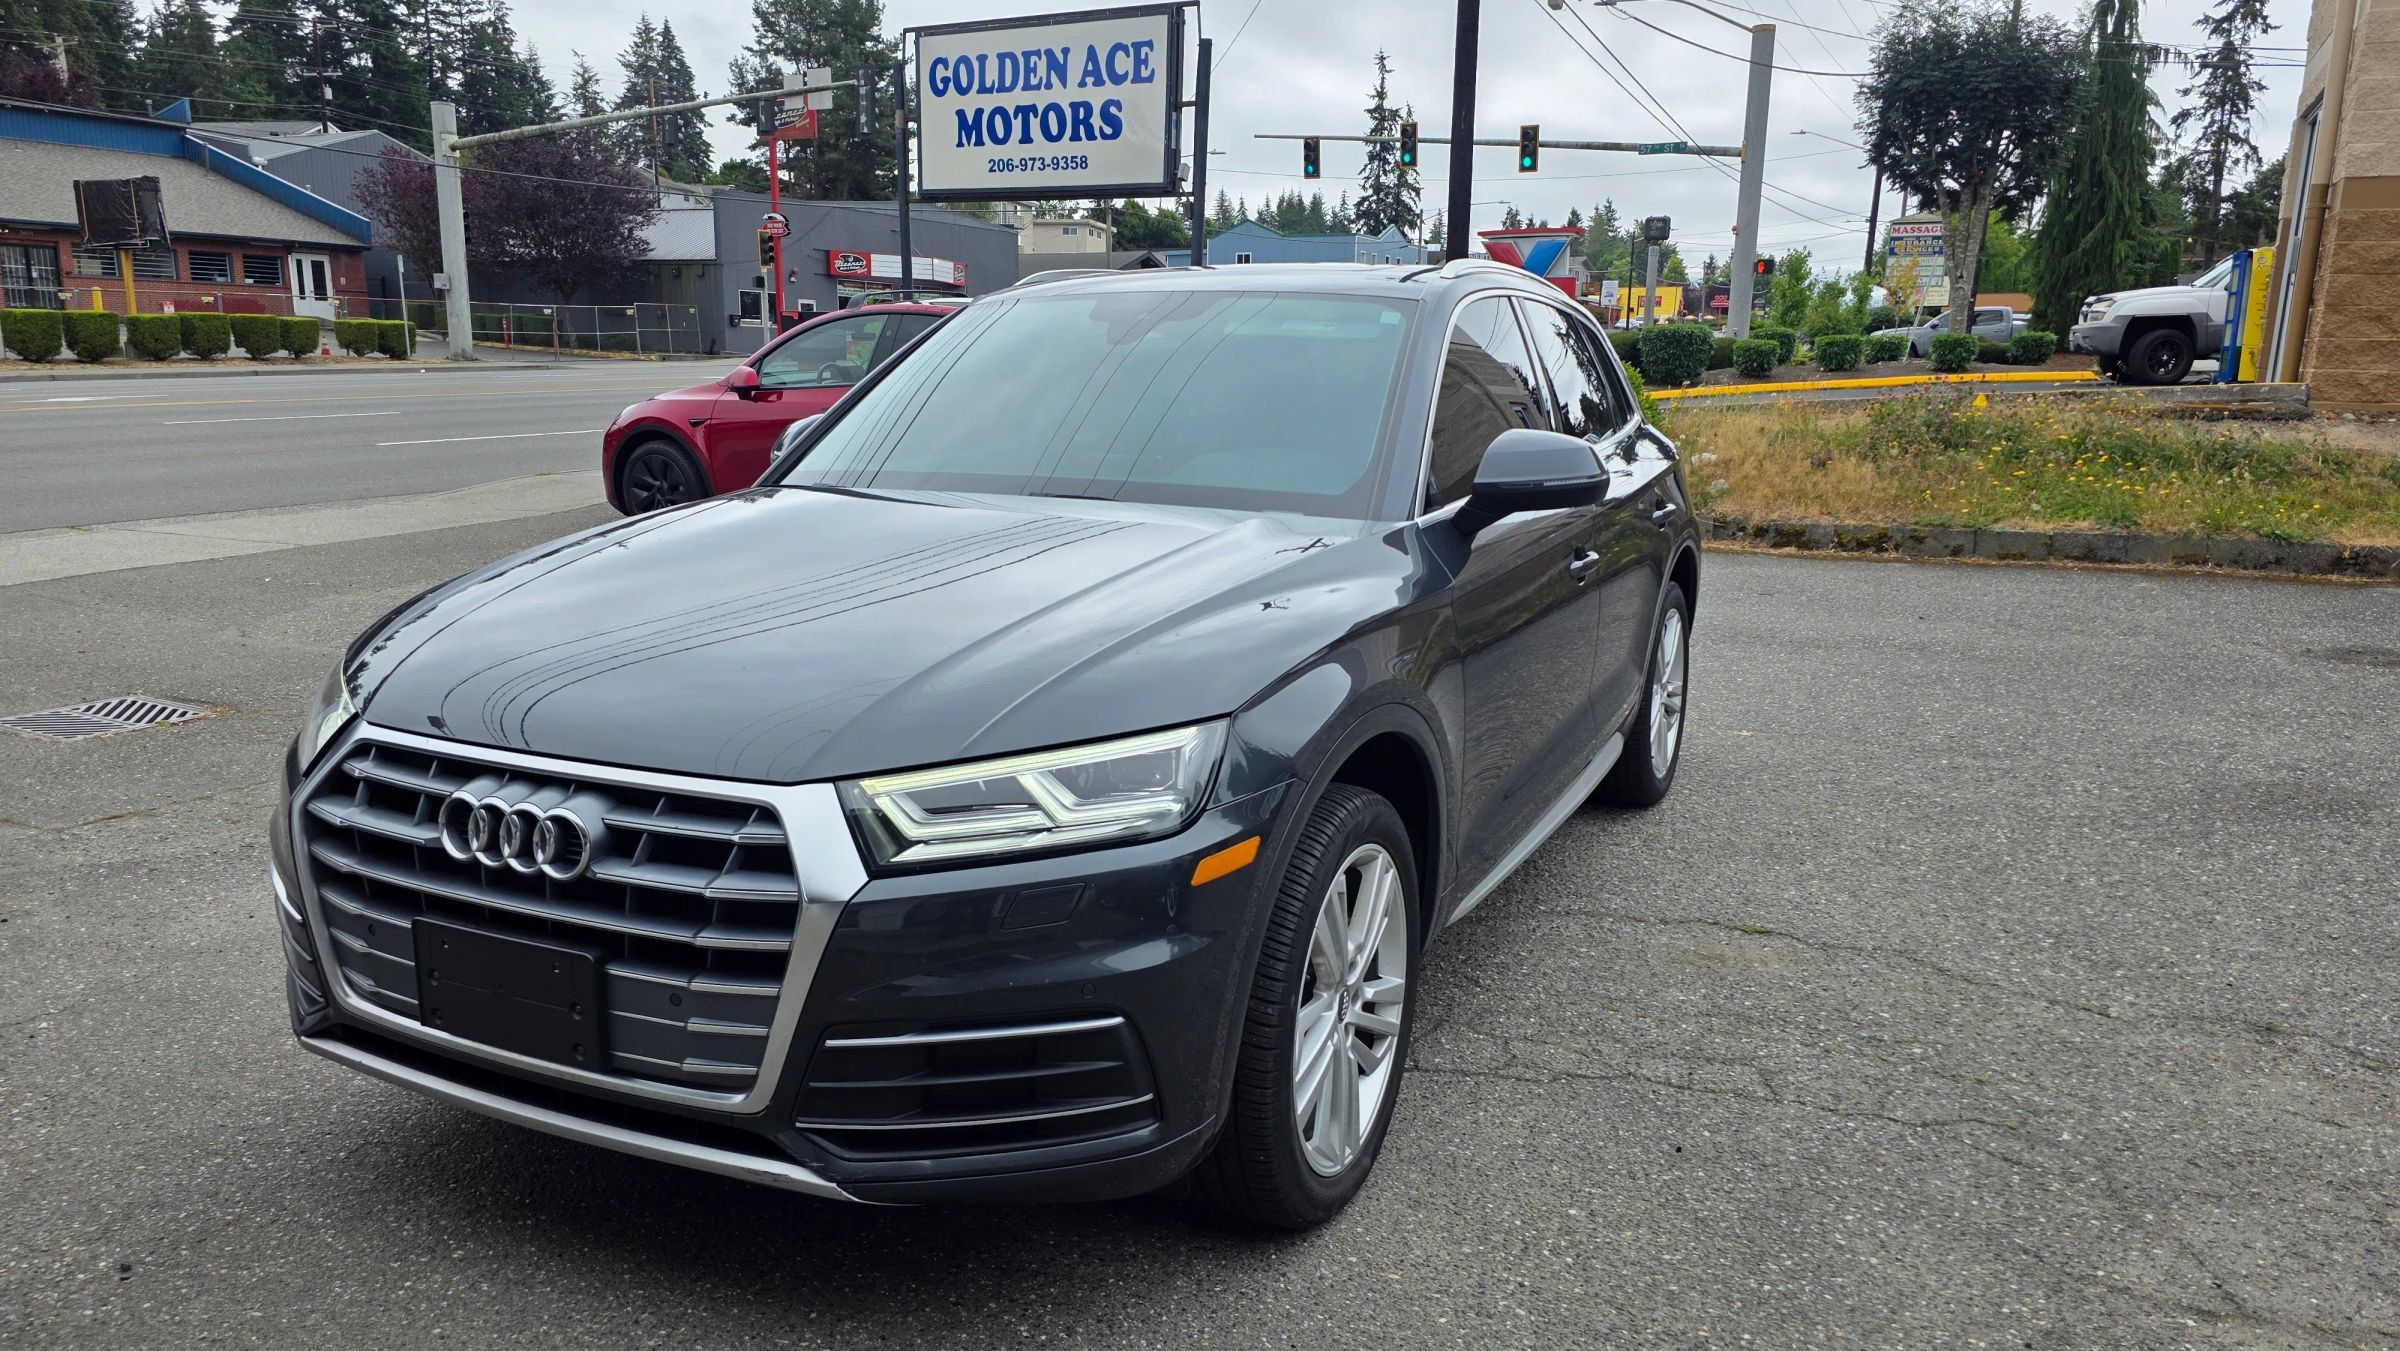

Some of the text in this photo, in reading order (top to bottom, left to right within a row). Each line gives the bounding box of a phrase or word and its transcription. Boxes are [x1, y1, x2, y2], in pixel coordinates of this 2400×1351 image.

[928, 39, 1155, 97] GOLDEN ACE
[955, 99, 1123, 148] MOTORS
[987, 155, 1089, 173] 206-973-9358
